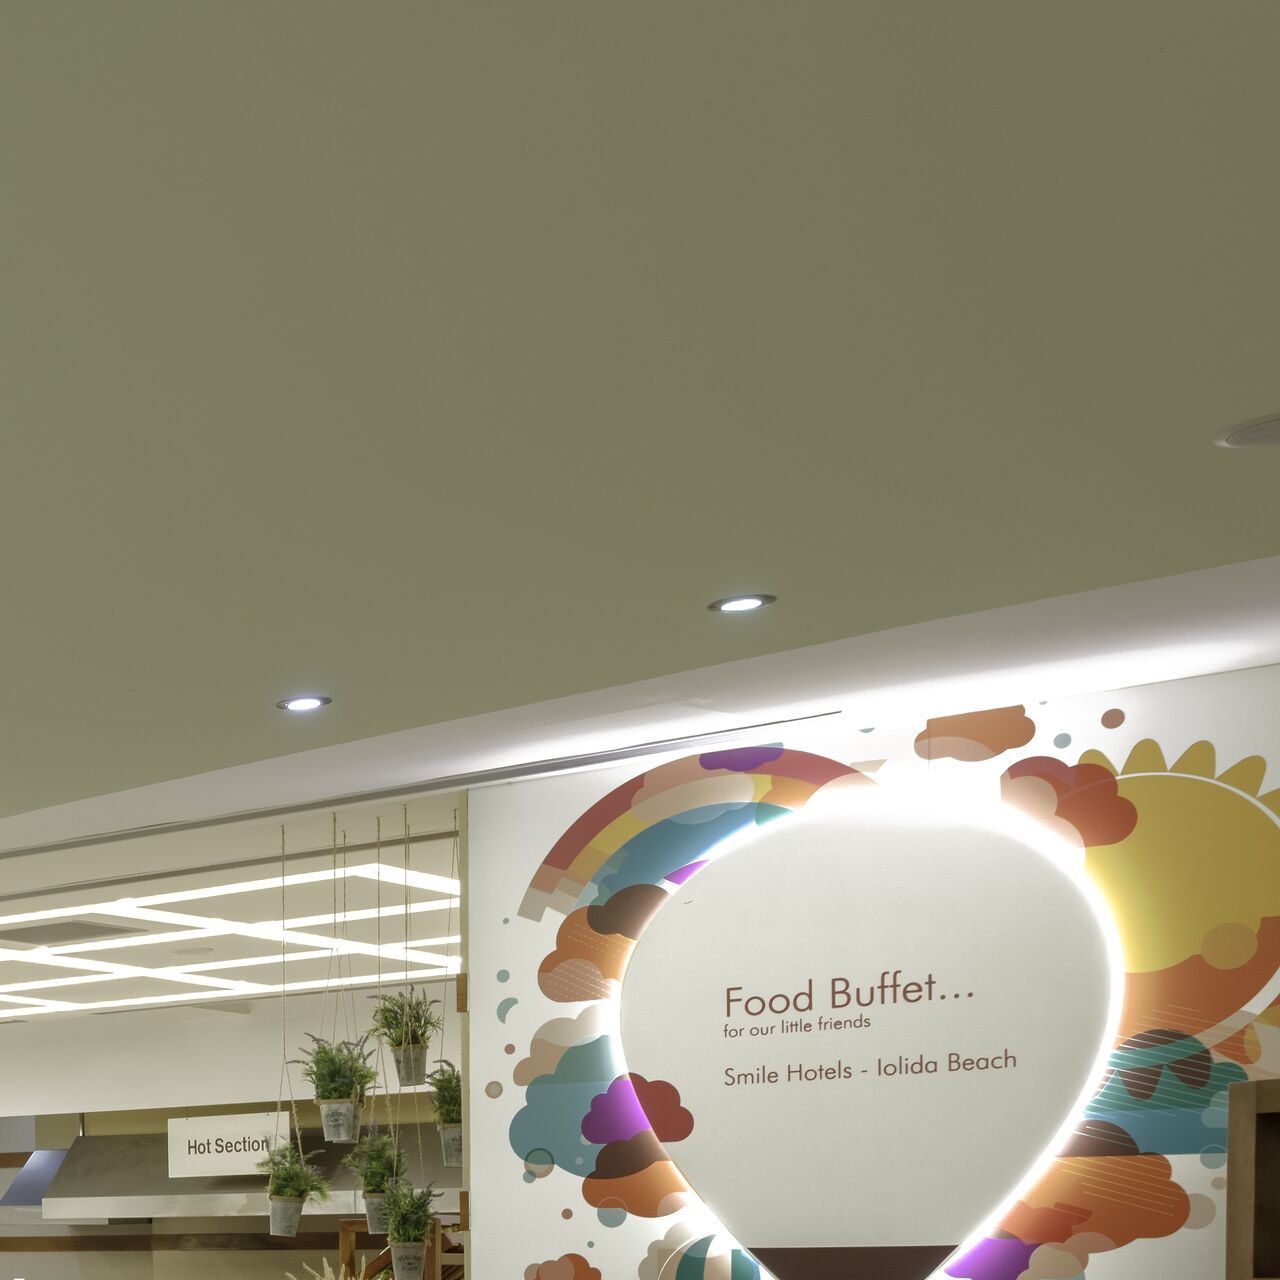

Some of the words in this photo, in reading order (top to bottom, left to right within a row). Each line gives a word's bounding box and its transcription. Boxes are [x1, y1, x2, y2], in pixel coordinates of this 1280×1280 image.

[726, 978, 813, 1018] Food
[831, 970, 974, 1009] Buffet...
[723, 1023, 745, 1038] for
[749, 1025, 776, 1037] our
[781, 1018, 813, 1034] little
[818, 1013, 871, 1031] friends
[724, 1065, 779, 1086] Smile
[787, 1059, 852, 1082] Hotels
[948, 1048, 1017, 1072] Beach
[187, 1138, 212, 1155] Hot
[214, 1136, 270, 1154] Section
